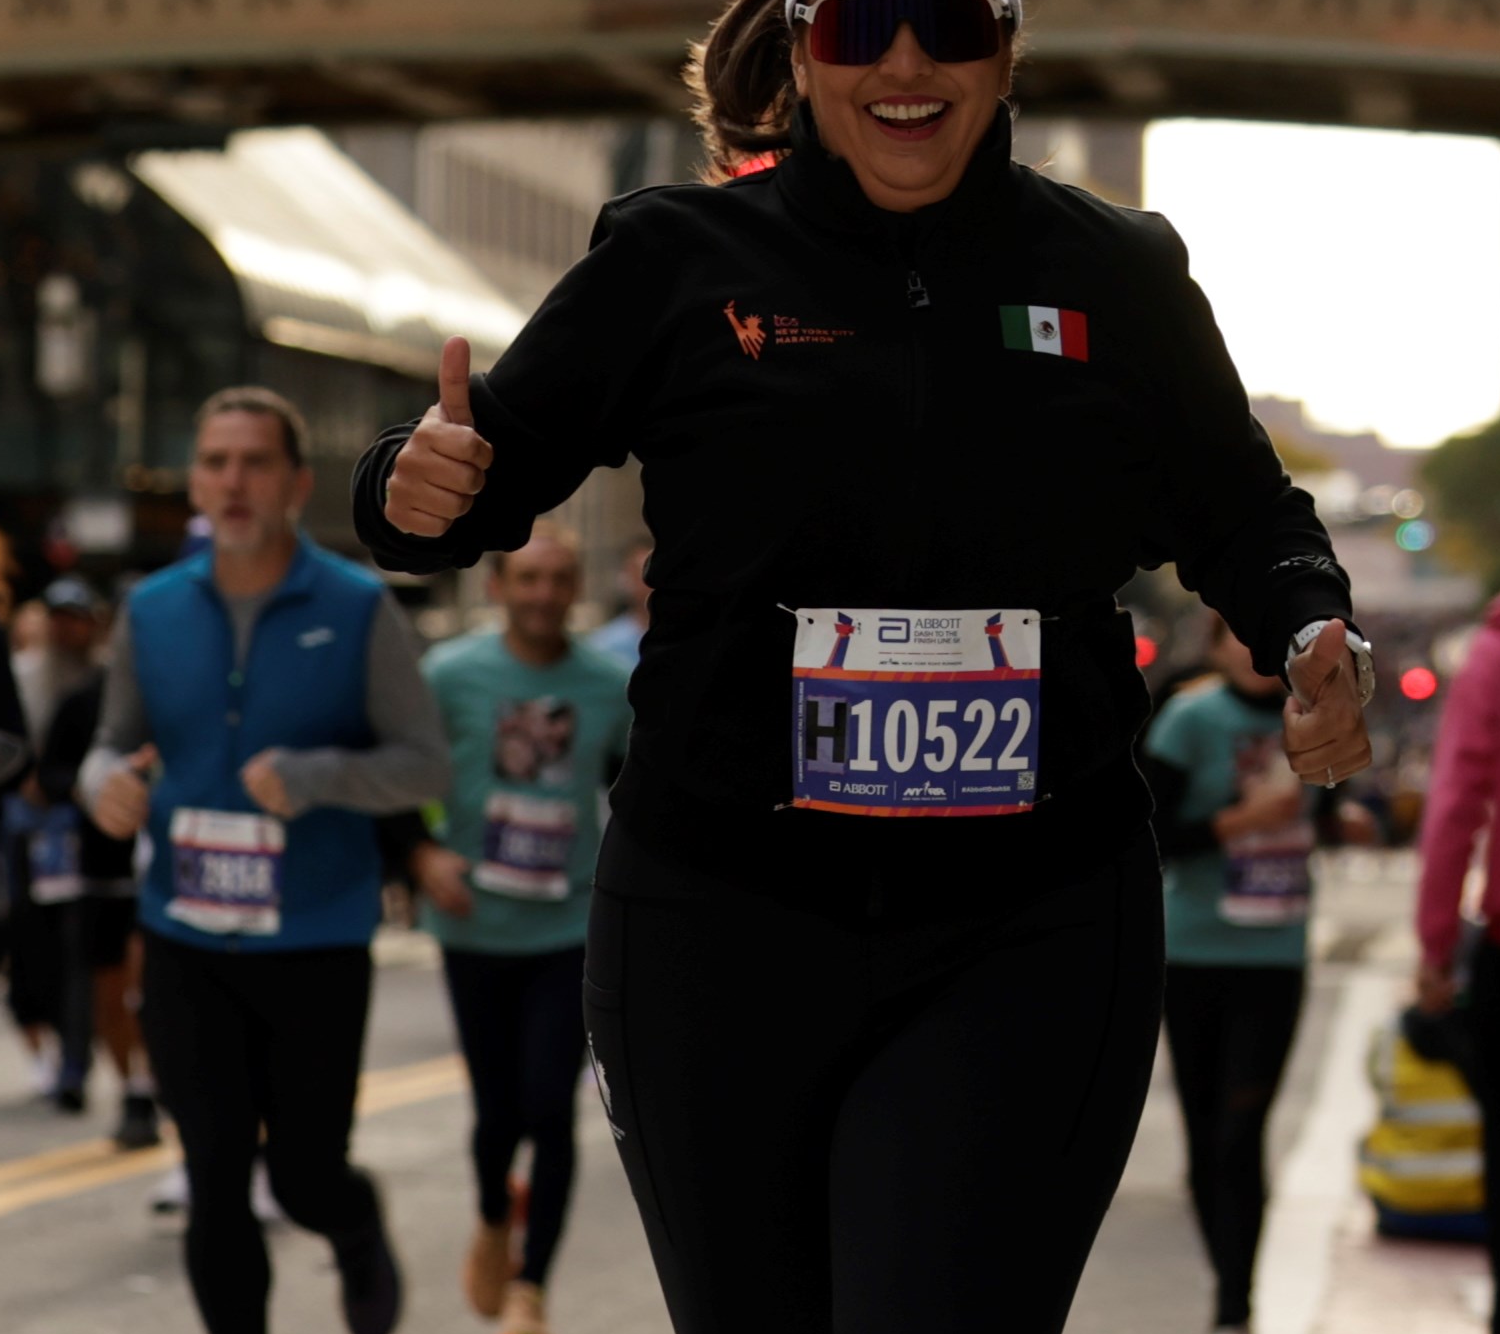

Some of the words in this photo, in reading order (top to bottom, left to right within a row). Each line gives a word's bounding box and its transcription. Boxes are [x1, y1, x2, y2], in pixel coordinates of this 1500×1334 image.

[775, 327, 800, 335] NEW
[802, 328, 829, 336] YORK
[775, 336, 835, 345] MARATHON
[914, 618, 962, 629] ABBOTT
[843, 783, 888, 795] ABBOTT
